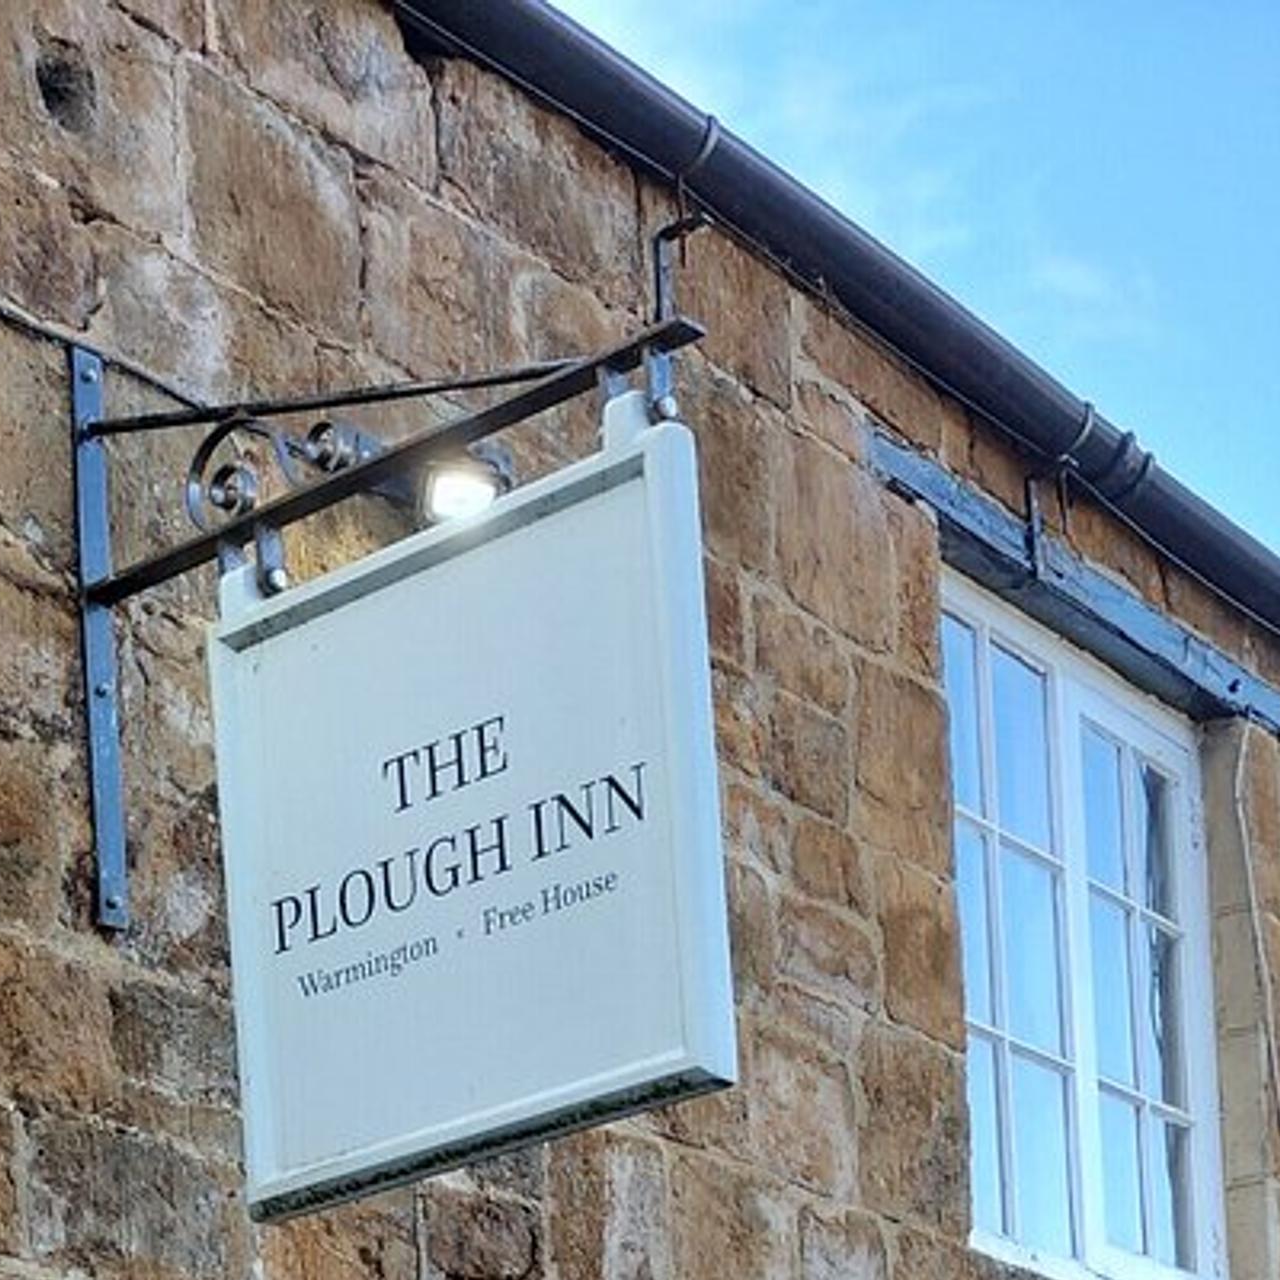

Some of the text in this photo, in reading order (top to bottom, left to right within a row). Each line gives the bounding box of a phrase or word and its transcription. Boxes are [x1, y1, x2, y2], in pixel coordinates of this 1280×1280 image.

[382, 716, 508, 813] THE
[270, 762, 648, 954] PLOUGH INN
[297, 872, 617, 998] Warmington Free House
